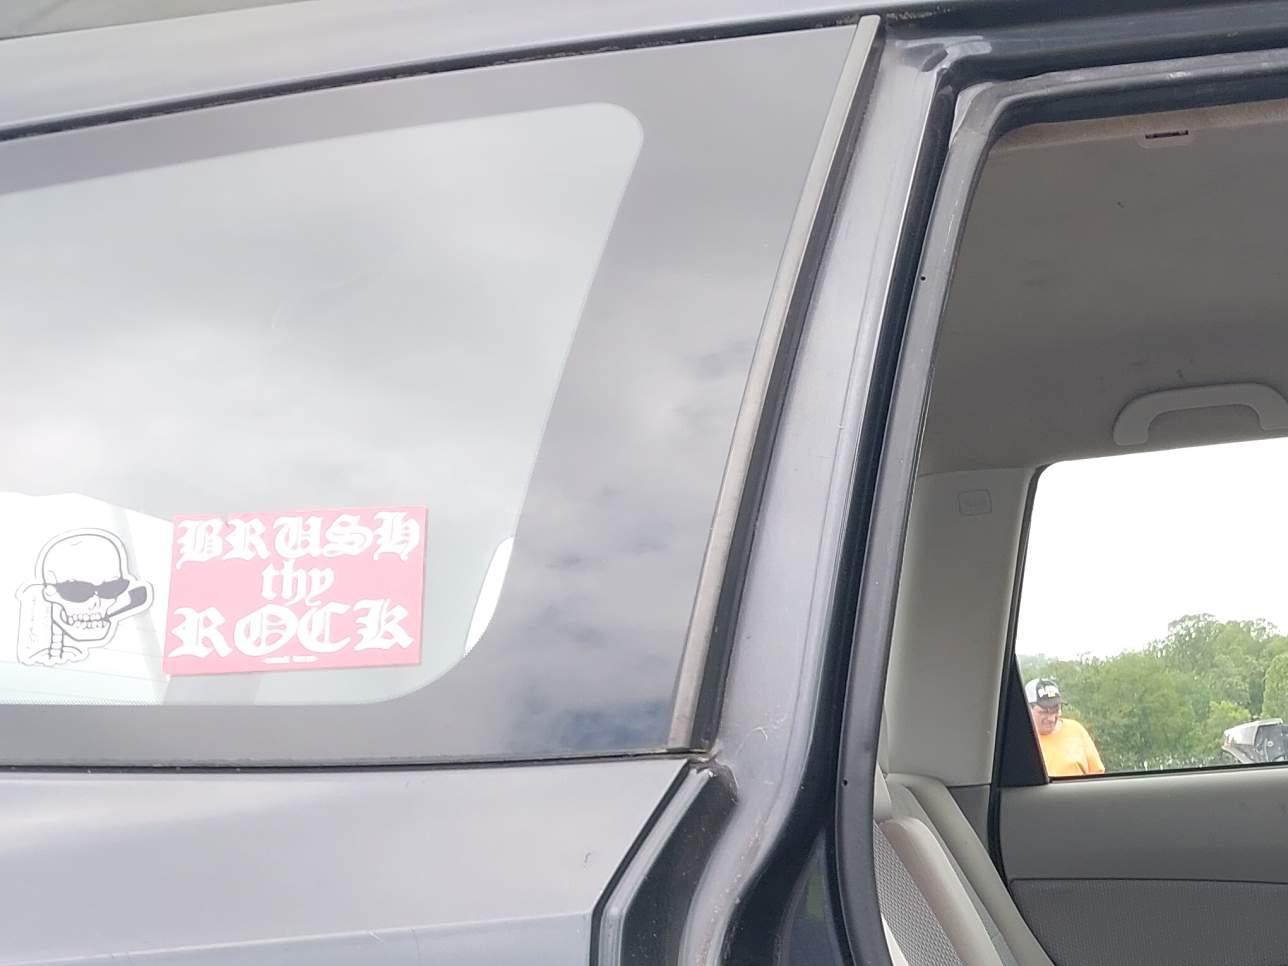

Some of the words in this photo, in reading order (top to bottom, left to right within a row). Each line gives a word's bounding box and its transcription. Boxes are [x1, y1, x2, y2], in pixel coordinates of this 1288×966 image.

[176, 511, 421, 569] BRUSH
[261, 560, 335, 606] thy
[168, 599, 415, 659] ROCK
